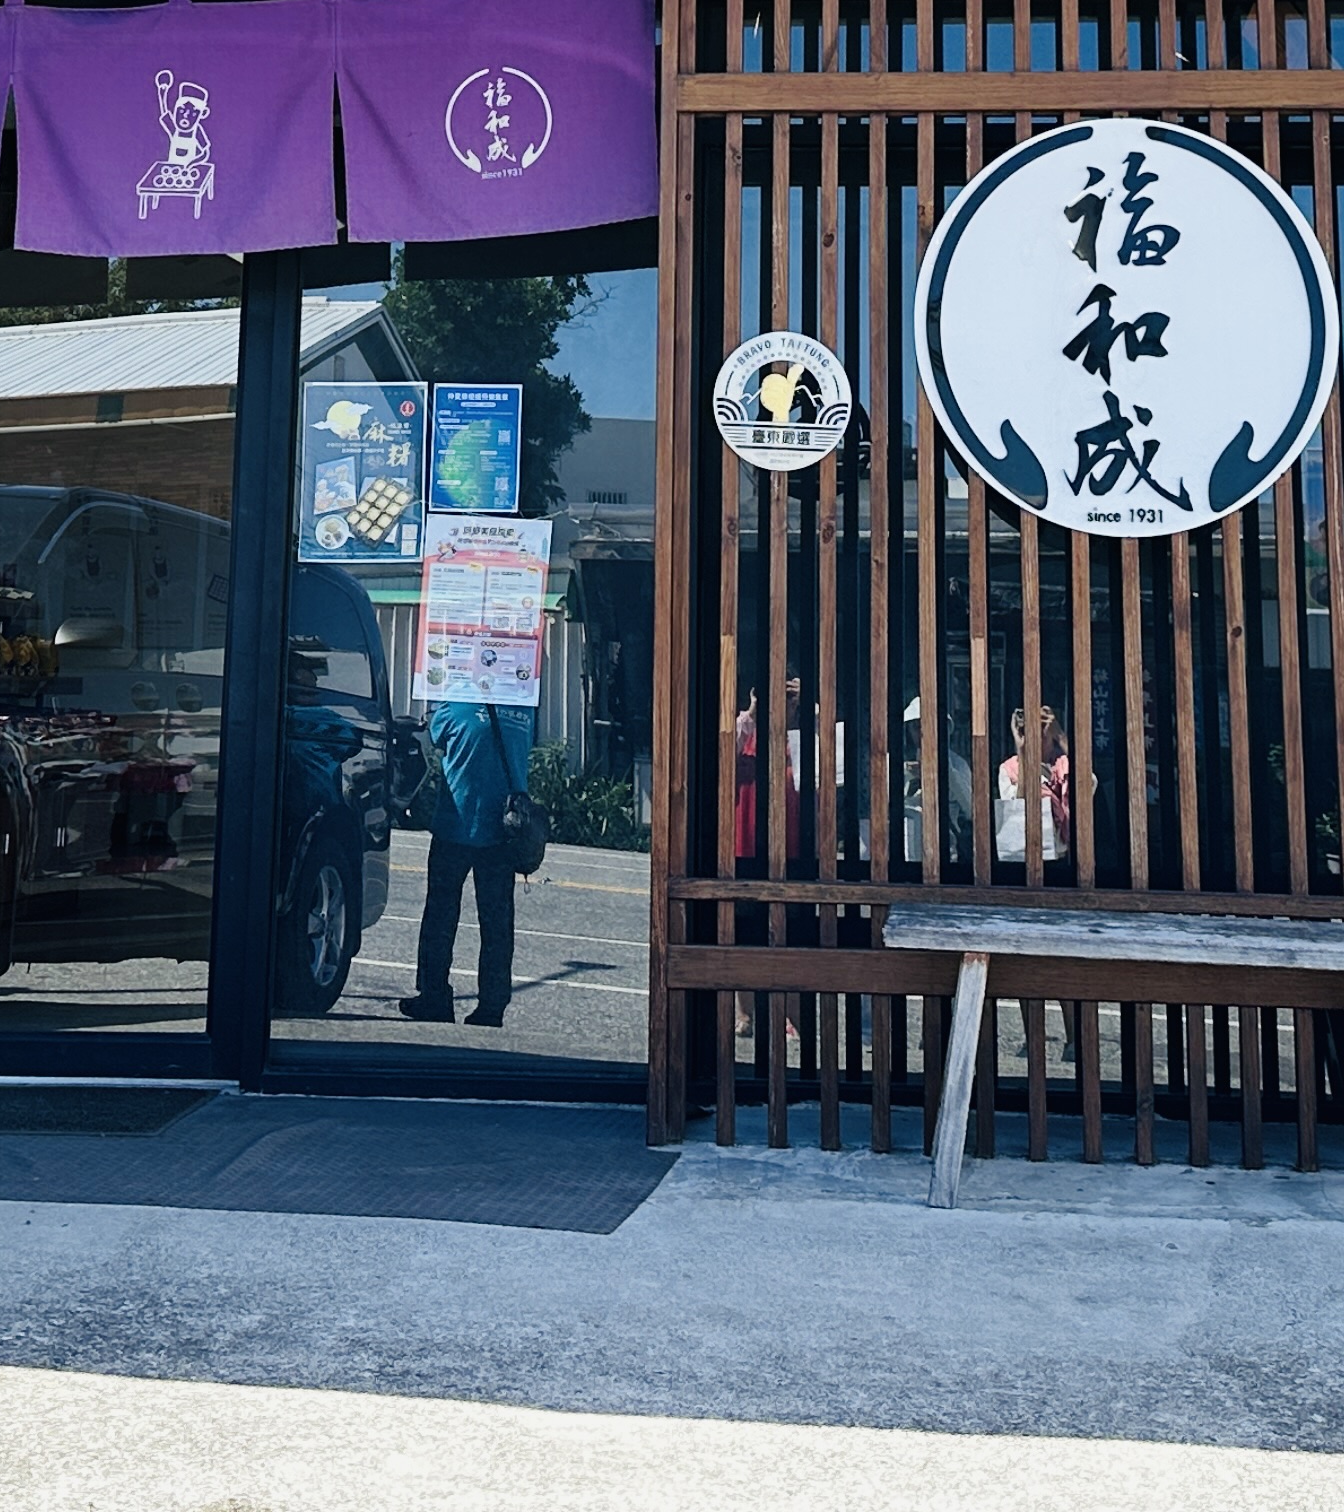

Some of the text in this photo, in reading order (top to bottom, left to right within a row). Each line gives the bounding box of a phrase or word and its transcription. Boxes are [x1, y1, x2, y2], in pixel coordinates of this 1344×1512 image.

[483, 78, 516, 162] 福和成
[737, 338, 830, 368] BRAVO TAITUNG
[1061, 151, 1194, 512] 福和成
[1087, 507, 1163, 523] since 1931
